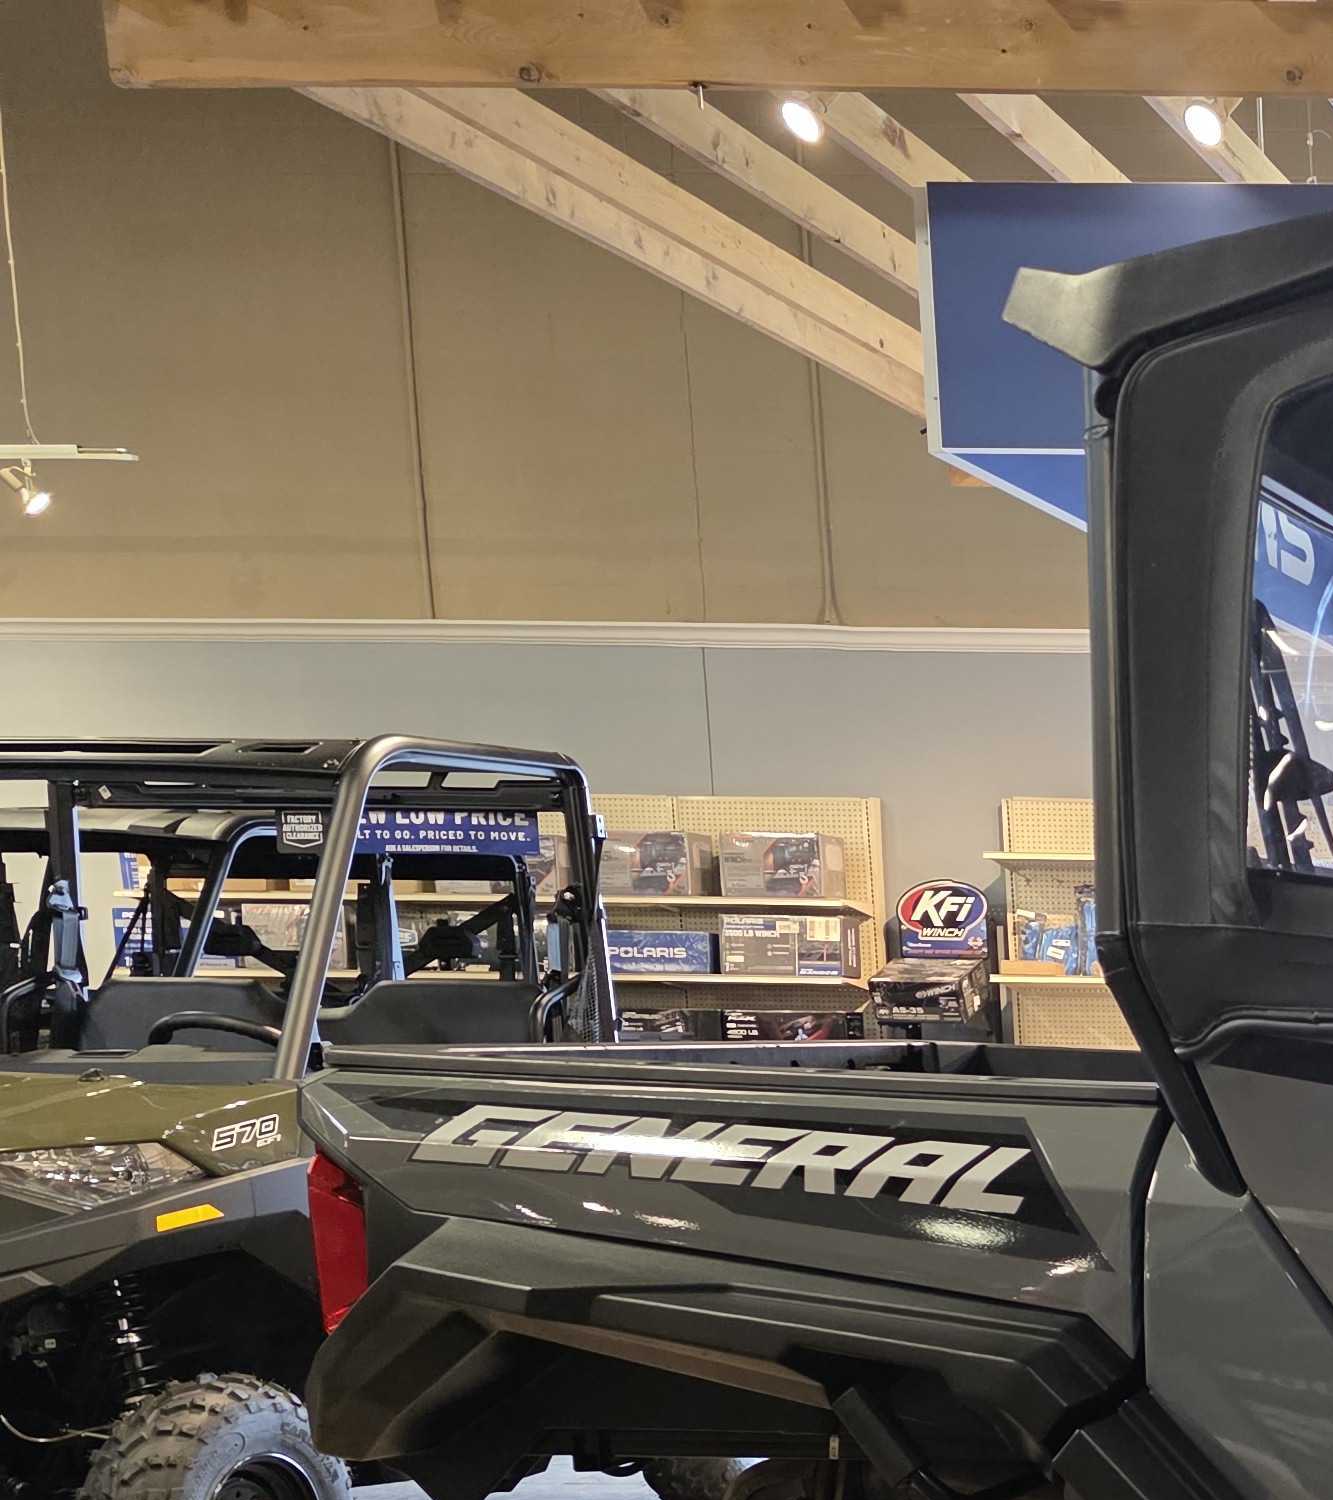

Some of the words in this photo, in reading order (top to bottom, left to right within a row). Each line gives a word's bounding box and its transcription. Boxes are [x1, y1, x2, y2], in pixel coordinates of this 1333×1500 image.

[375, 830, 390, 839] TO
[420, 831, 464, 840] PRICED
[469, 831, 485, 840] TO
[490, 832, 531, 841] MOVE.
[921, 927, 965, 938] WINCH
[608, 947, 687, 959] POLARIS
[212, 1113, 280, 1152] 570
[411, 1104, 1031, 1215] GENERAL
